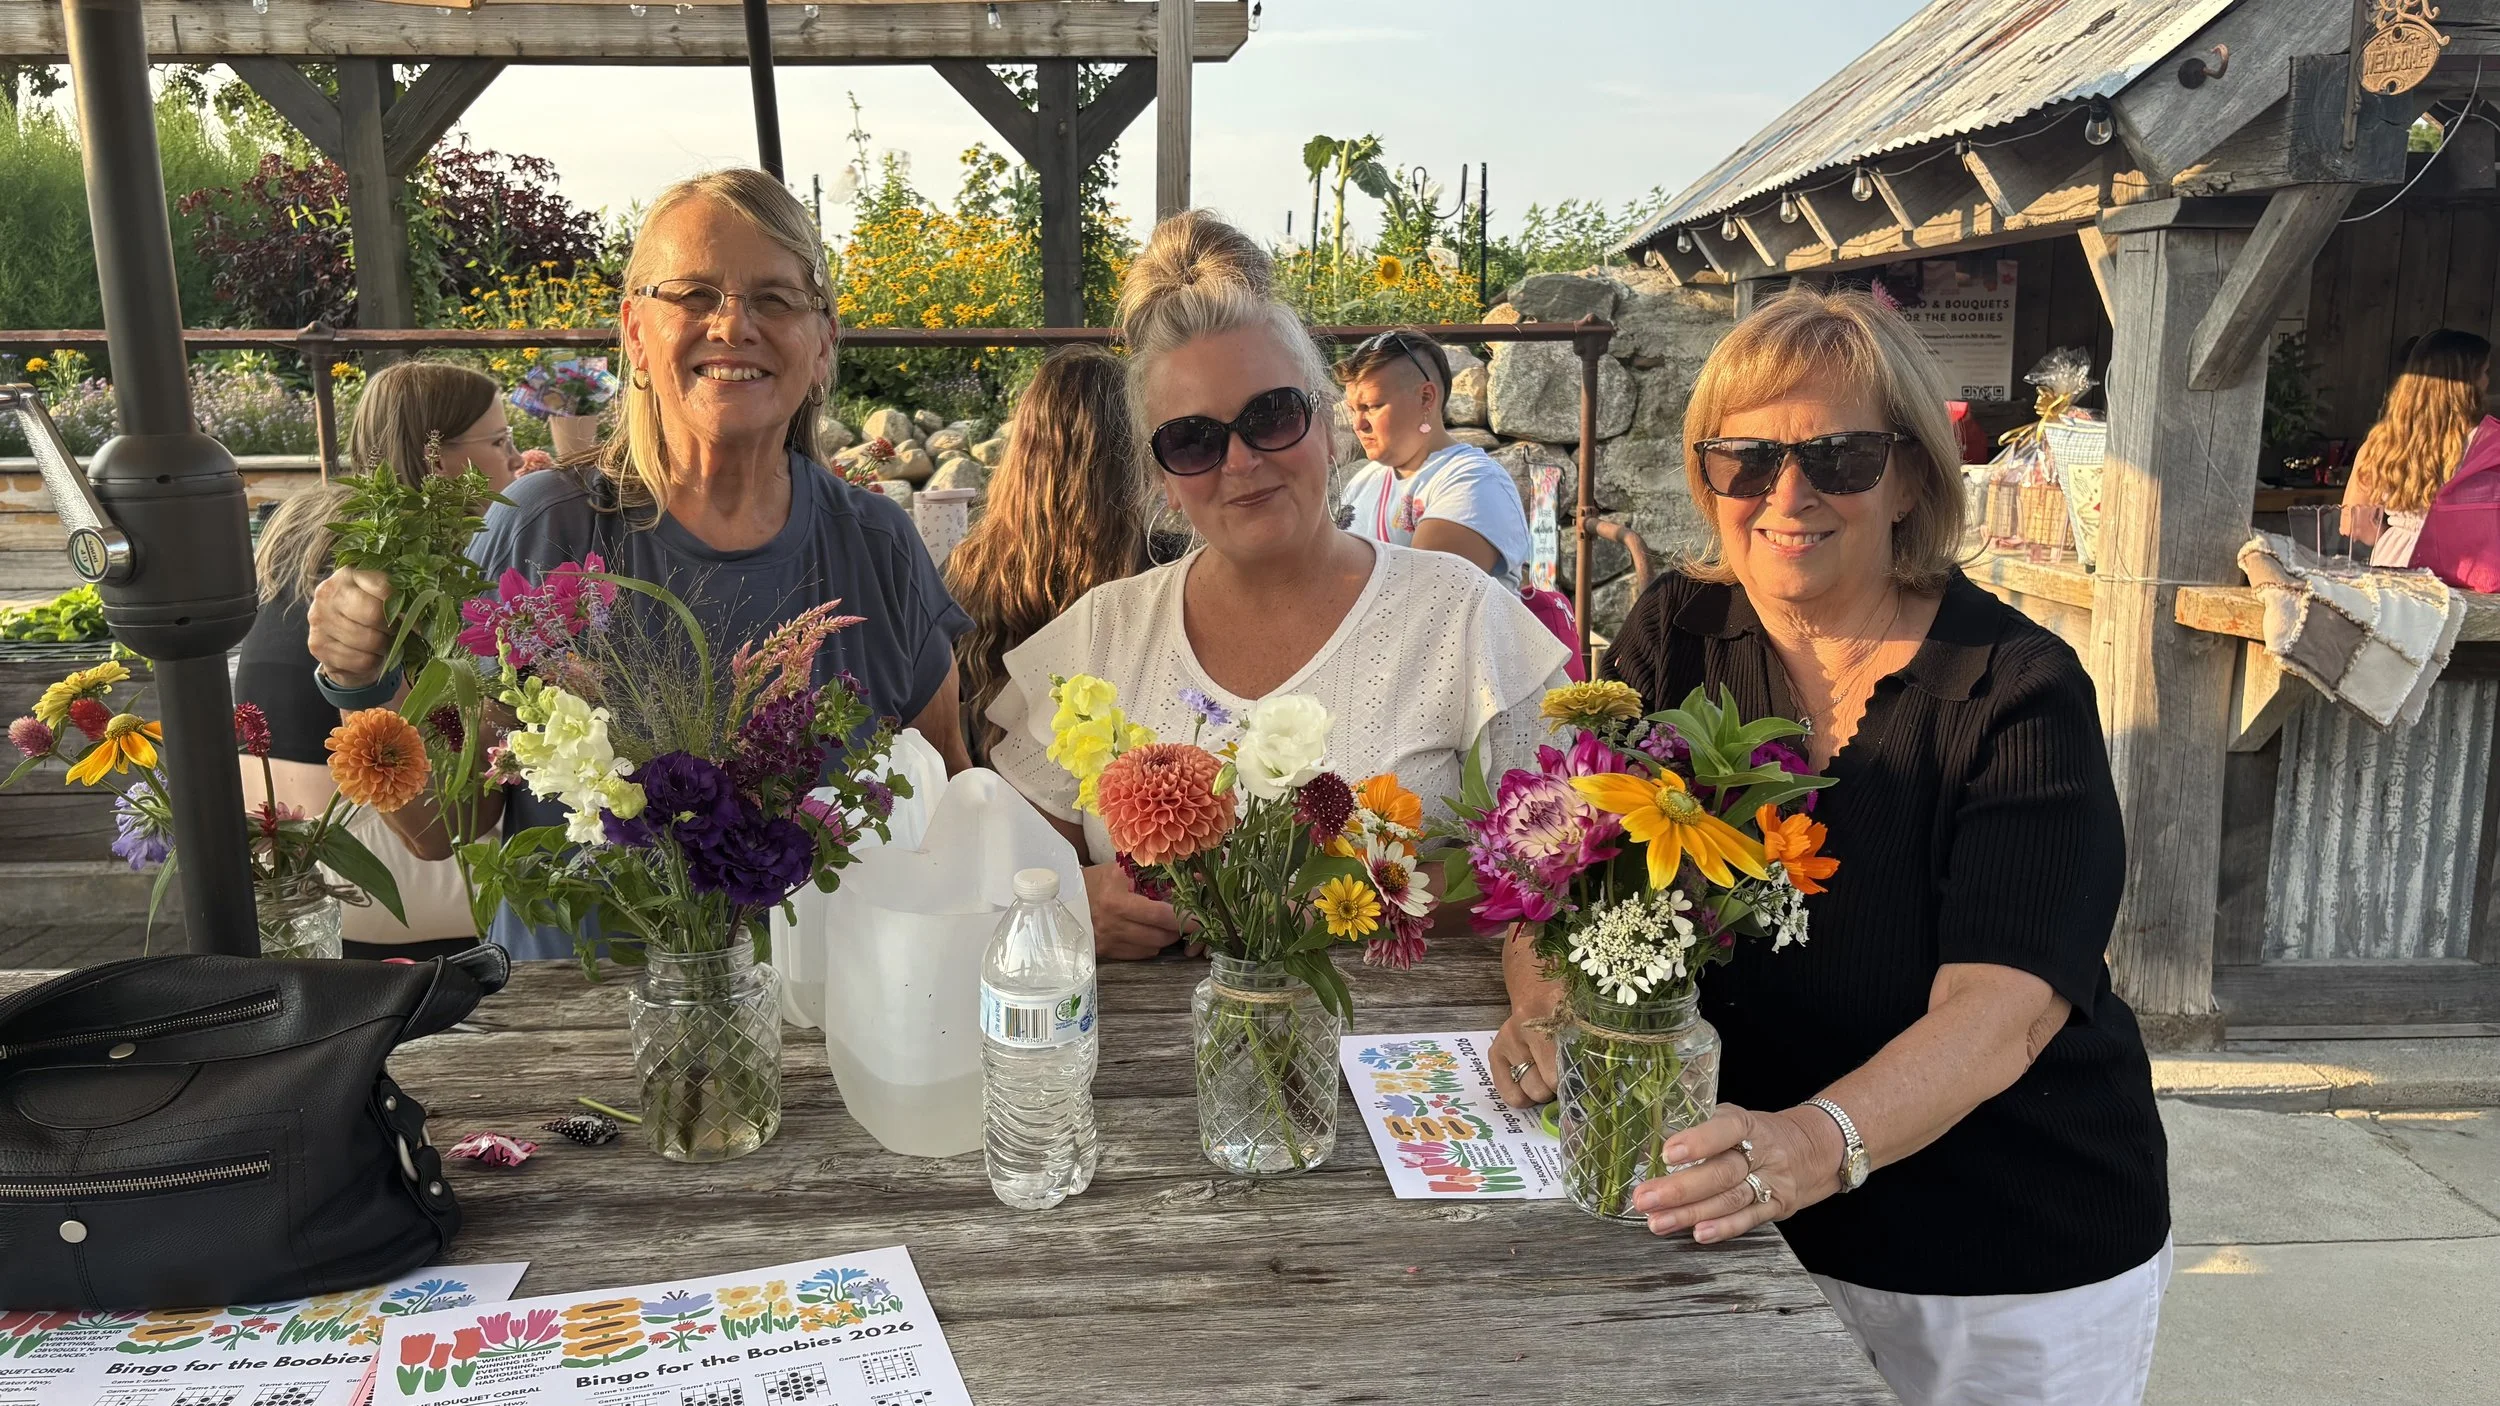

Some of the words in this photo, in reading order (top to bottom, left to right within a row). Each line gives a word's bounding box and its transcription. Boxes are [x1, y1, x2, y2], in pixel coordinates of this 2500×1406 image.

[2364, 44, 2430, 75] WELCOME
[1945, 299, 2009, 310] BOUQUETS
[1902, 313, 1920, 322] OR
[1925, 313, 1946, 322] THE
[1951, 312, 2003, 322] BOOBIES
[88, 540, 98, 563] DOWN
[1455, 1038, 1477, 1057] 2026
[1469, 1057, 1494, 1087] Boobies
[1485, 1087, 1502, 1100] the
[1493, 1101, 1509, 1112] for
[1503, 1113, 1523, 1134] Bingo
[1521, 1142, 1535, 1159] CORRAL
[1529, 1158, 1546, 1180] BOUQUET
[1540, 1178, 1550, 1187] THE
[576, 1371, 650, 1388] Bingo
[656, 1362, 694, 1375] for
[701, 1354, 741, 1367] the
[747, 1336, 843, 1360] Boobies
[848, 1321, 914, 1341] 2026
[870, 1348, 897, 1357] Picture
[899, 1343, 923, 1351] Frame
[105, 1362, 178, 1376] Bingo
[183, 1359, 223, 1372] for
[228, 1358, 268, 1369] the
[273, 1352, 373, 1368] Boobies
[476, 1360, 518, 1369] WINNING
[787, 1362, 823, 1372] Diamond
[475, 1368, 530, 1381] OBVIOUSLY
[532, 1365, 562, 1373] NEVER
[714, 1377, 740, 1385] Crown
[626, 1383, 654, 1392] Classic
[434, 1394, 491, 1406] BOUQUET
[493, 1386, 541, 1398] CORRAL
